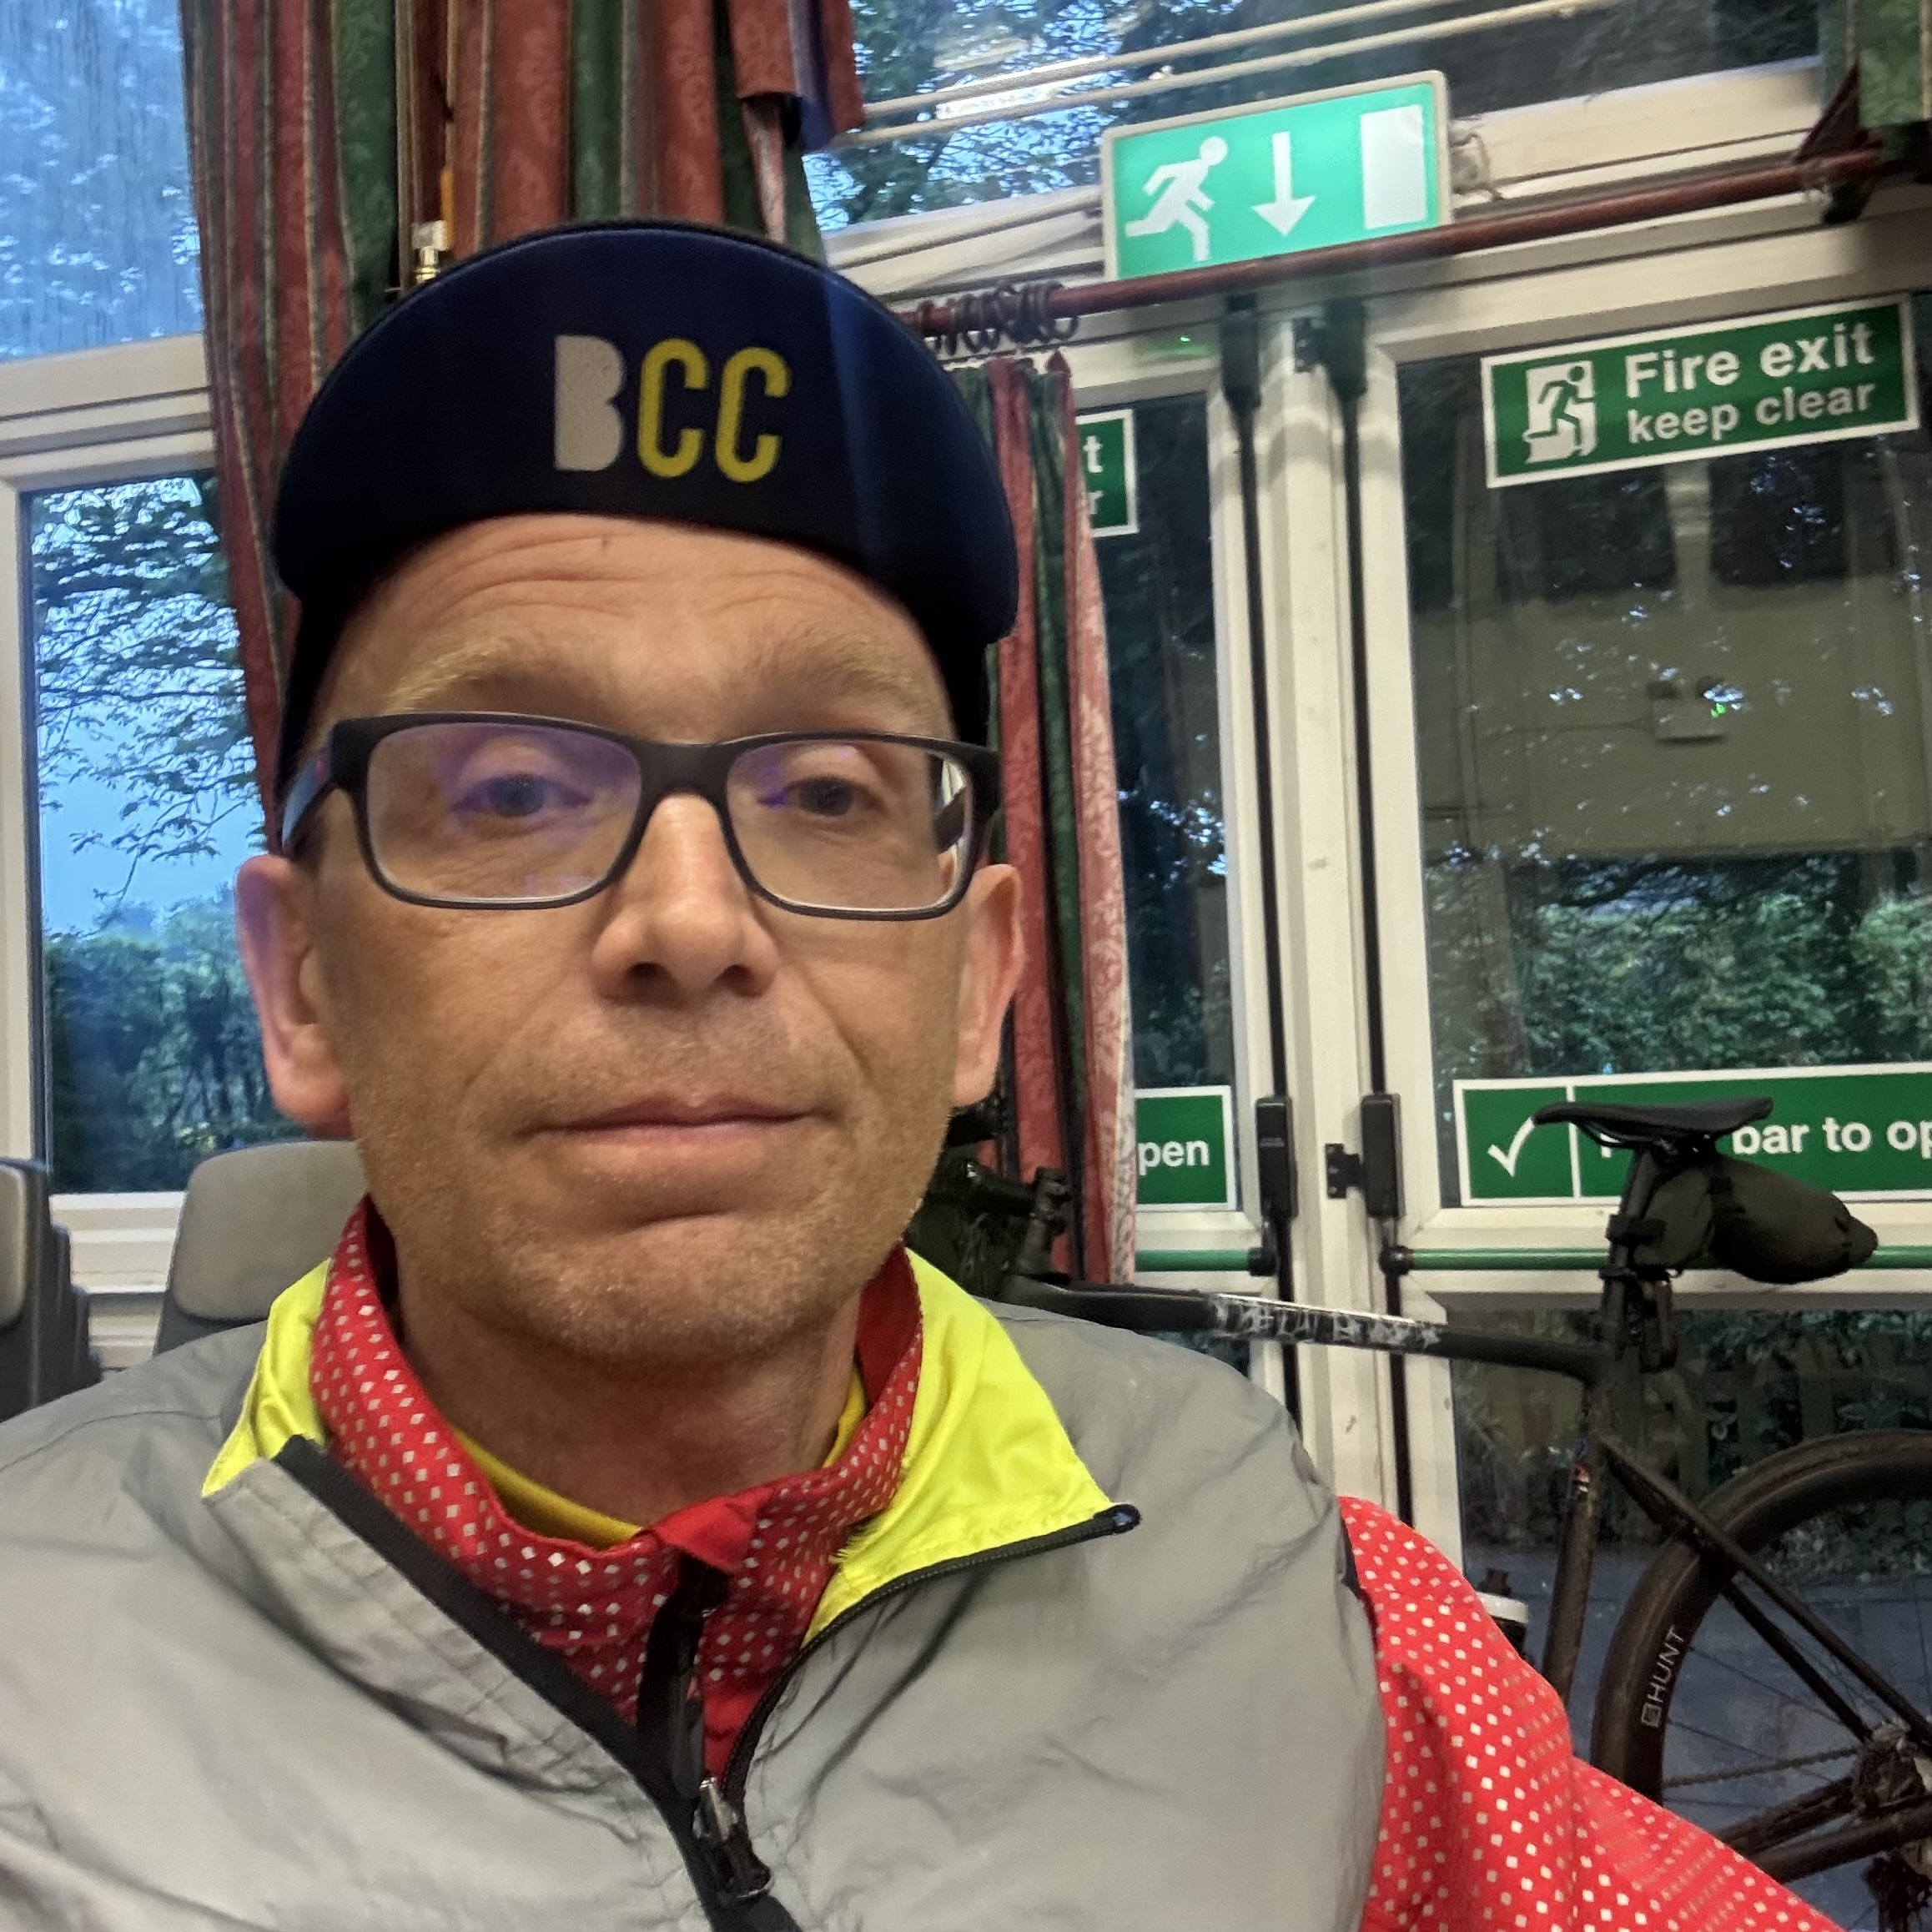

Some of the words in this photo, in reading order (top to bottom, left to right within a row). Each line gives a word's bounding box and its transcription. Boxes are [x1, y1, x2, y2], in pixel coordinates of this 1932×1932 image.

[1625, 350, 1740, 399] Fire
[1760, 322, 1874, 377] exit
[554, 335, 790, 482] BCC
[1628, 403, 1741, 444] keep
[1755, 384, 1875, 425] clear
[1732, 1124, 1809, 1155] bar
[1822, 1116, 1872, 1153] to
[1647, 1626, 1684, 1703] HUNT
